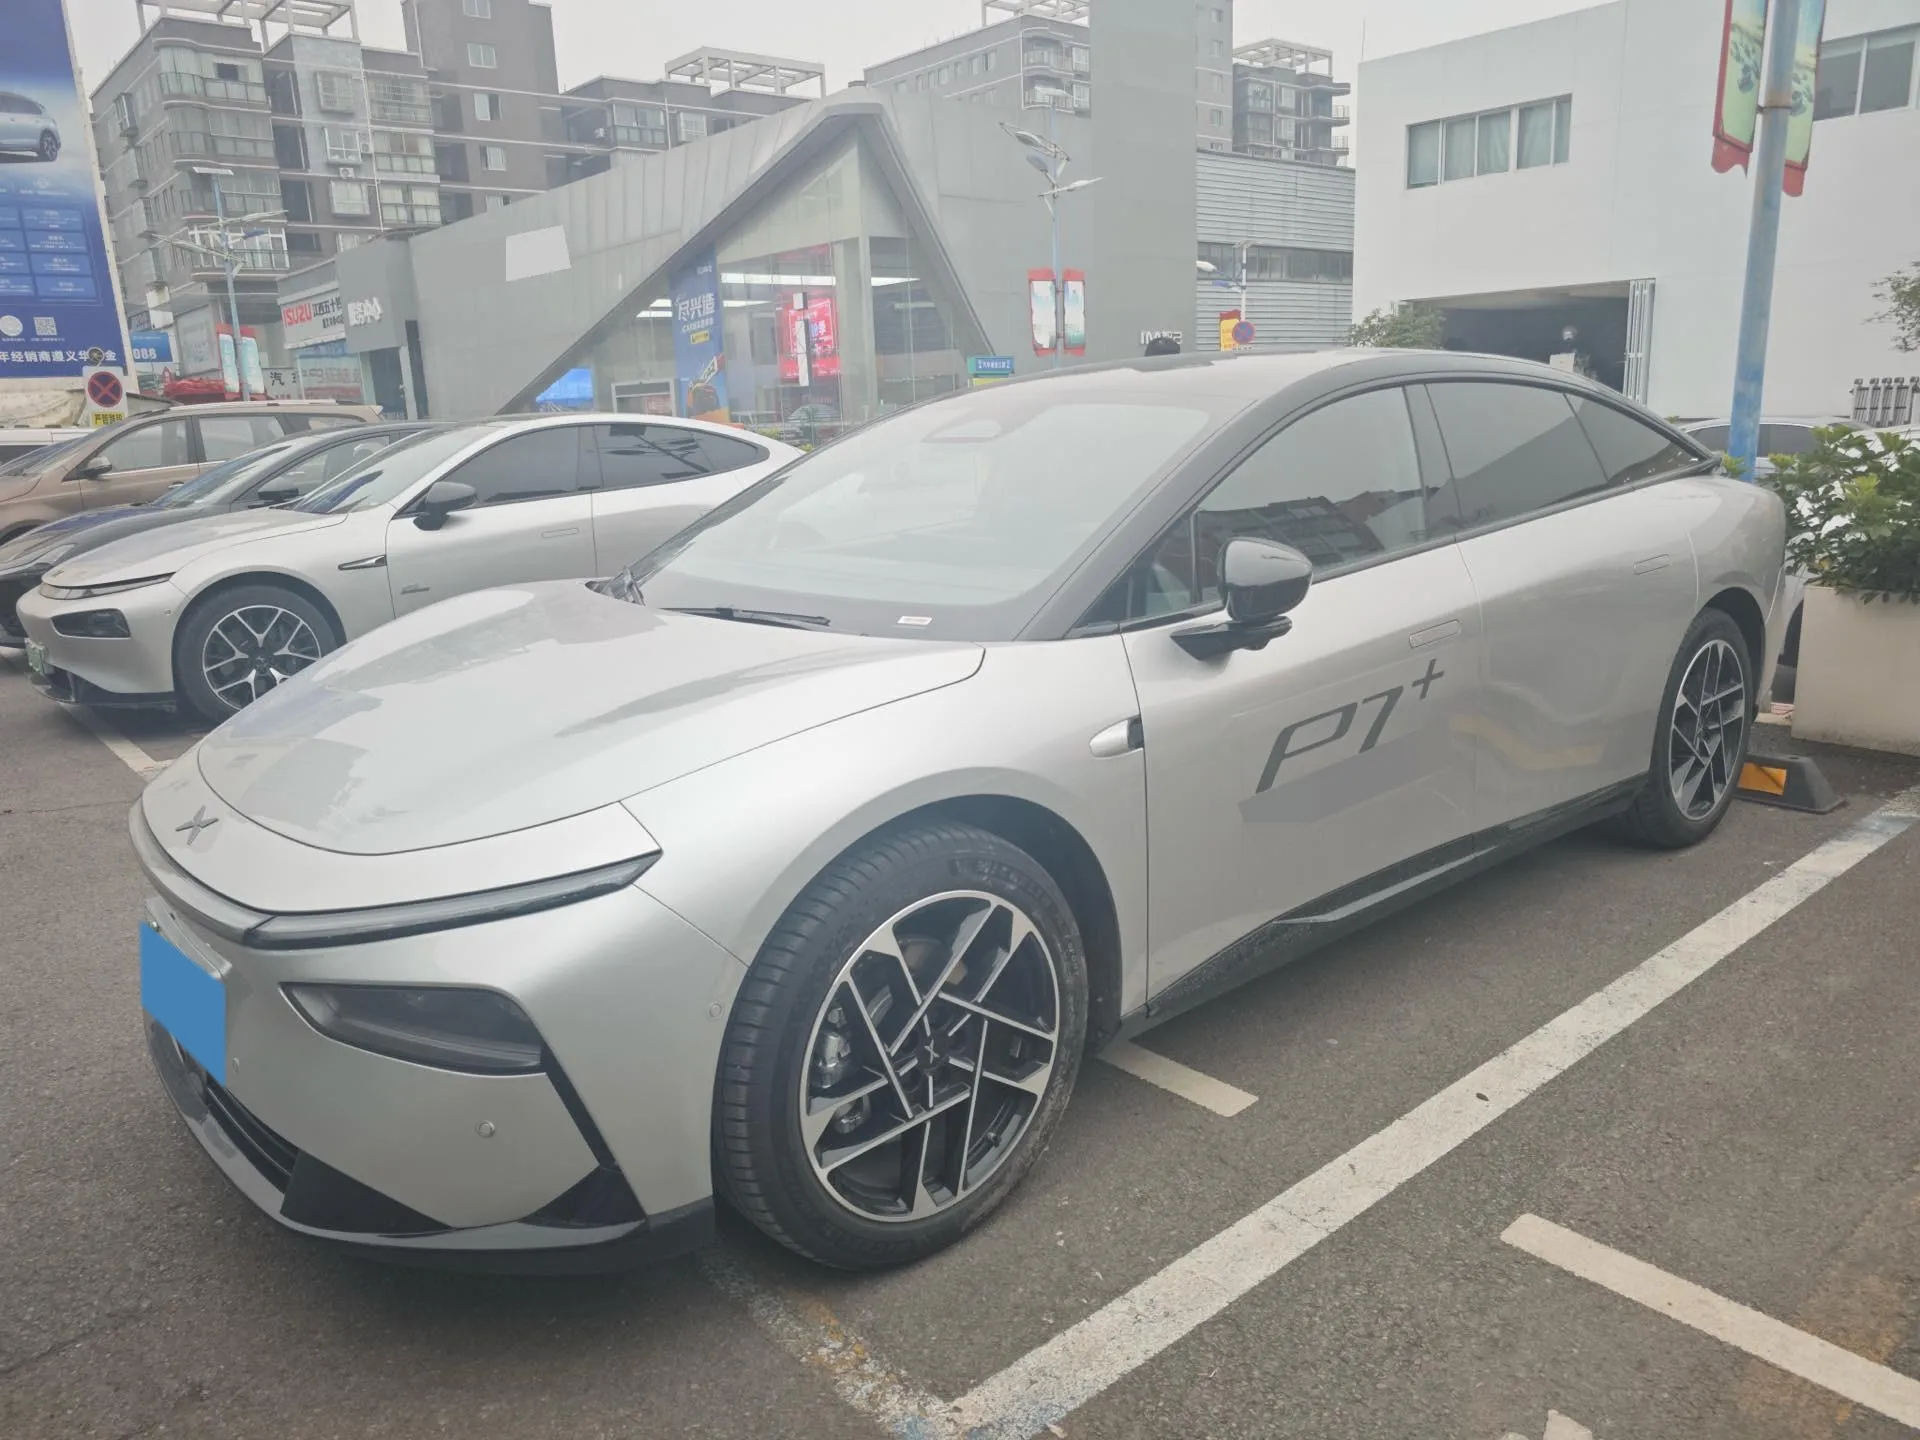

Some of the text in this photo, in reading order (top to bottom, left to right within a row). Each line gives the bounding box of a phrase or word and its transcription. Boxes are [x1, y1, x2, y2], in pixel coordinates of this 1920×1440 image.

[282, 302, 312, 328] ISUZU
[0, 350, 117, 363] 年经销商遵义华金
[1255, 658, 1445, 794] P7+
